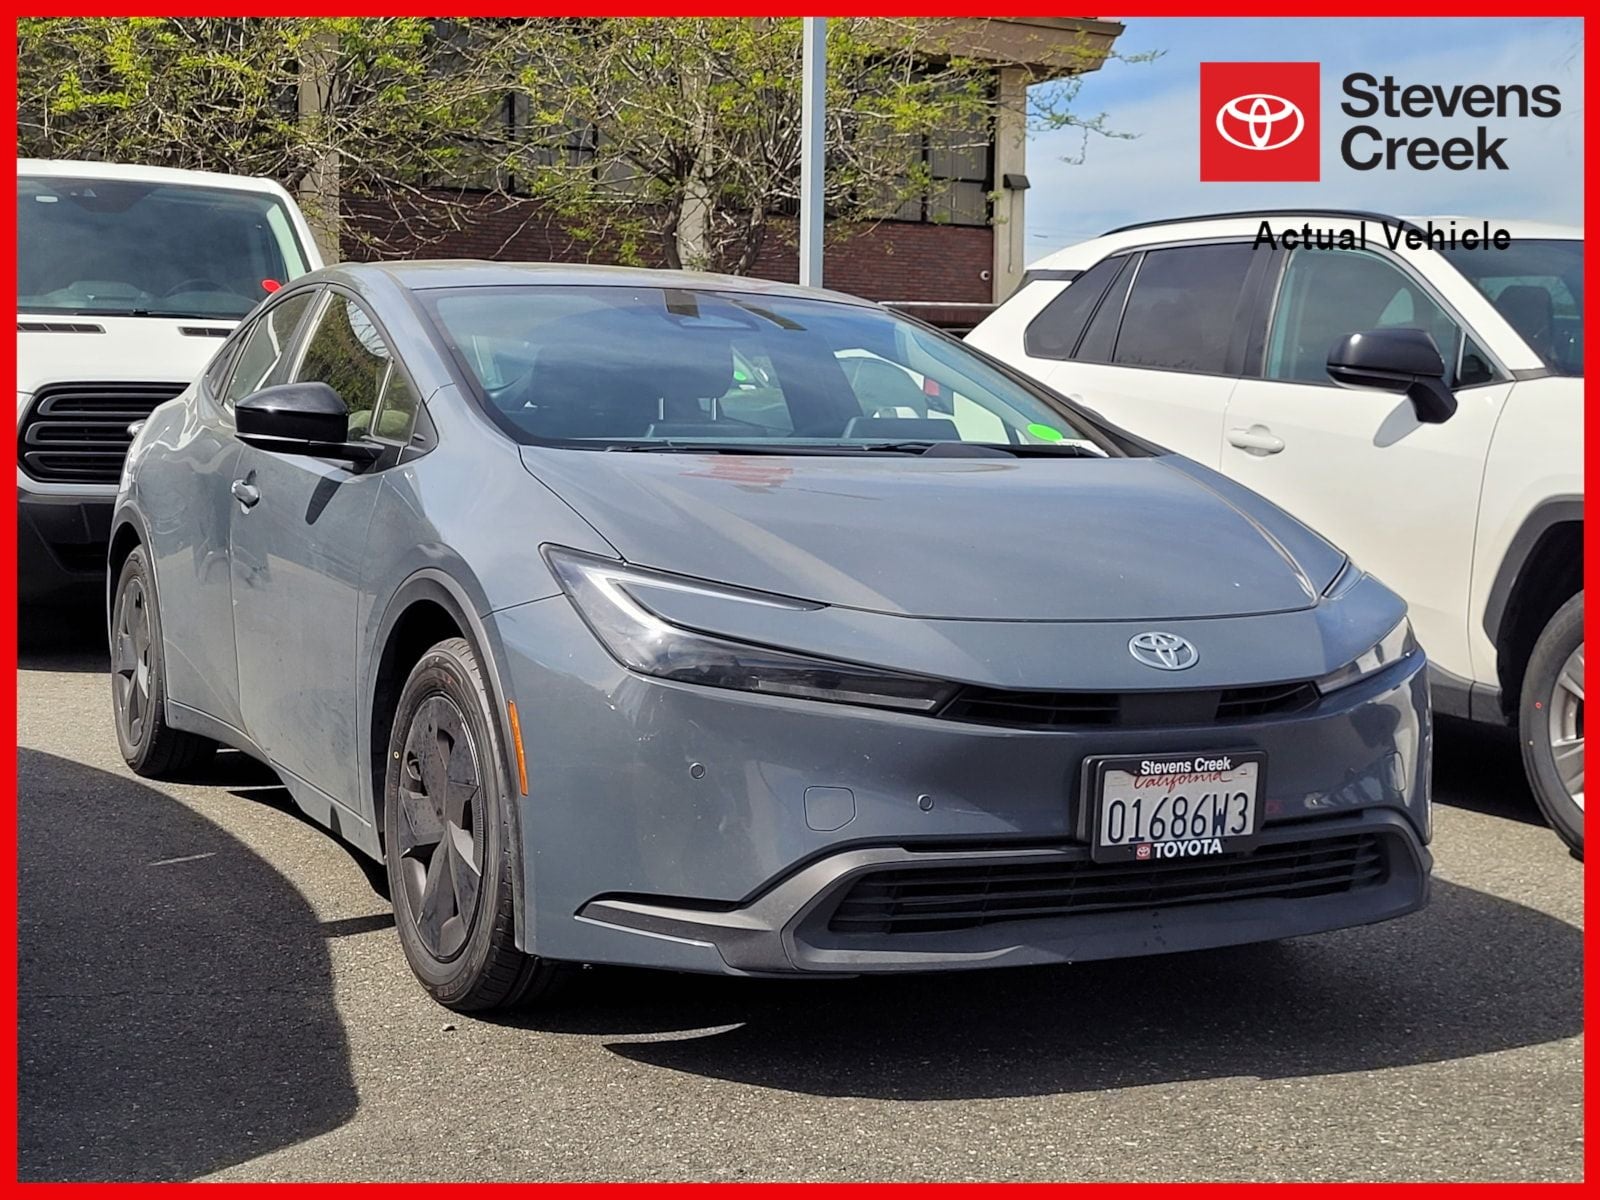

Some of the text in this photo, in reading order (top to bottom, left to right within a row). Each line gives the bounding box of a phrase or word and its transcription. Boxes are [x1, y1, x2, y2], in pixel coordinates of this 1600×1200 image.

[1141, 756, 1231, 776] Stevens Creek
[1107, 792, 1249, 844] 01686W3
[1154, 838, 1223, 859] TOYOTA
